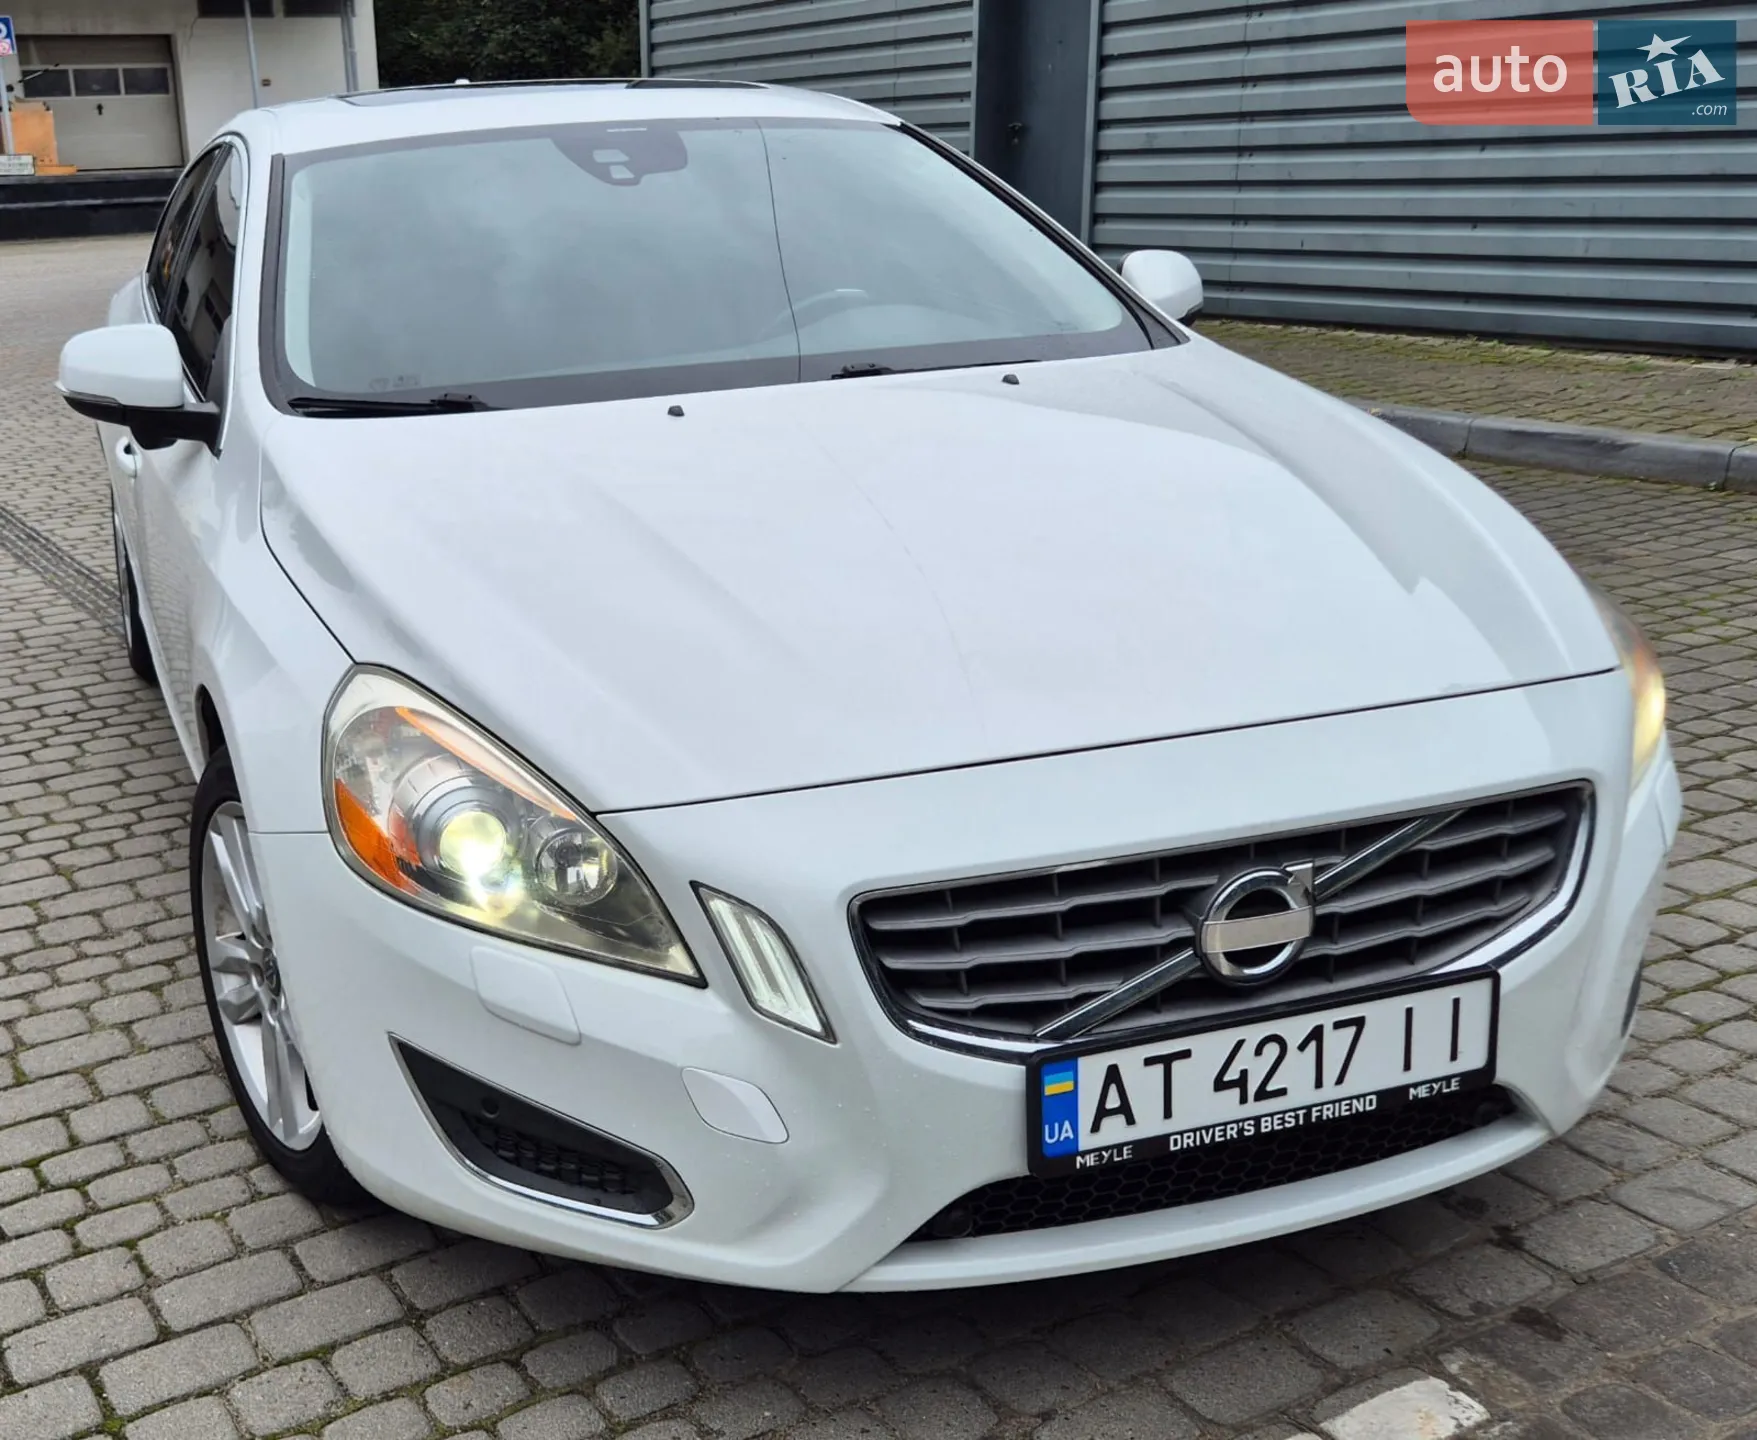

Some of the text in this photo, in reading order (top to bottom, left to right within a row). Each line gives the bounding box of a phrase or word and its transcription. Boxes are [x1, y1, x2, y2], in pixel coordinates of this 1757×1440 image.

[1090, 1048, 1192, 1134] AT
[1213, 1015, 1366, 1106] 4217
[1409, 1077, 1461, 1100] MEYLE
[1044, 1119, 1074, 1144] UA
[1169, 1094, 1377, 1151] DRIVER'S BEST FRIEND
[1076, 1145, 1133, 1170] MEYLE
